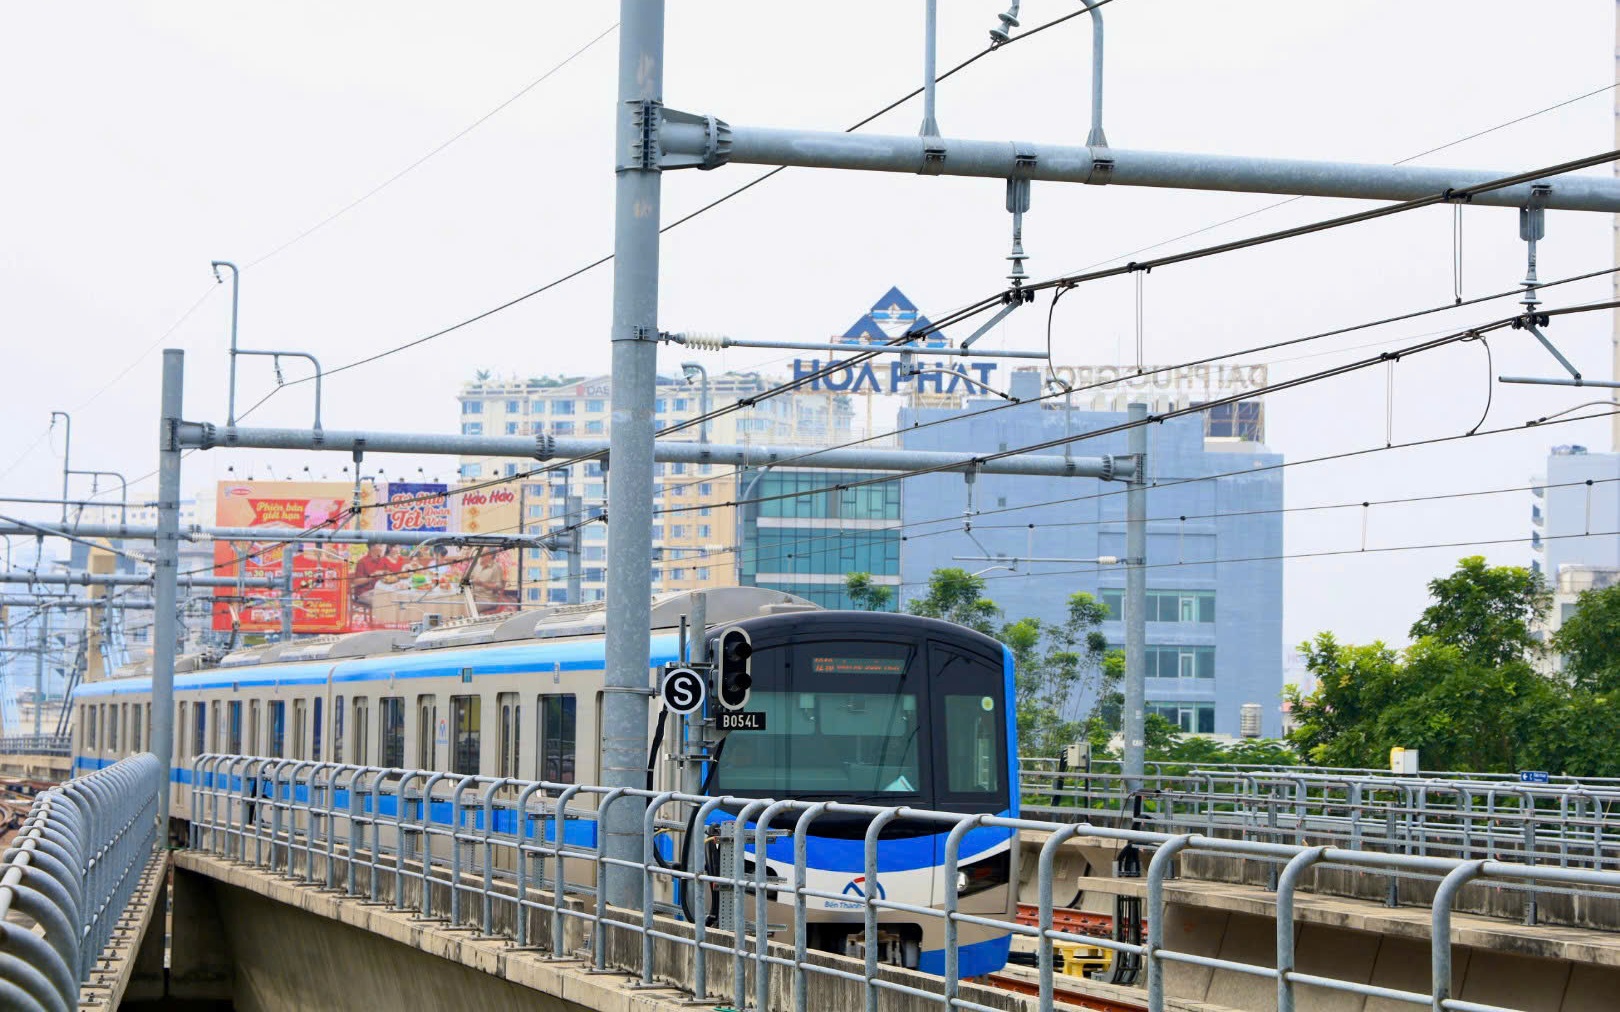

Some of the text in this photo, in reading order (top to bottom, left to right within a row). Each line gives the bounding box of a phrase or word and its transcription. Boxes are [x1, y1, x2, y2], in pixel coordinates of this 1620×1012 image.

[586, 385, 611, 396] DAE
[673, 677, 693, 706] S
[723, 714, 759, 728] B054L
